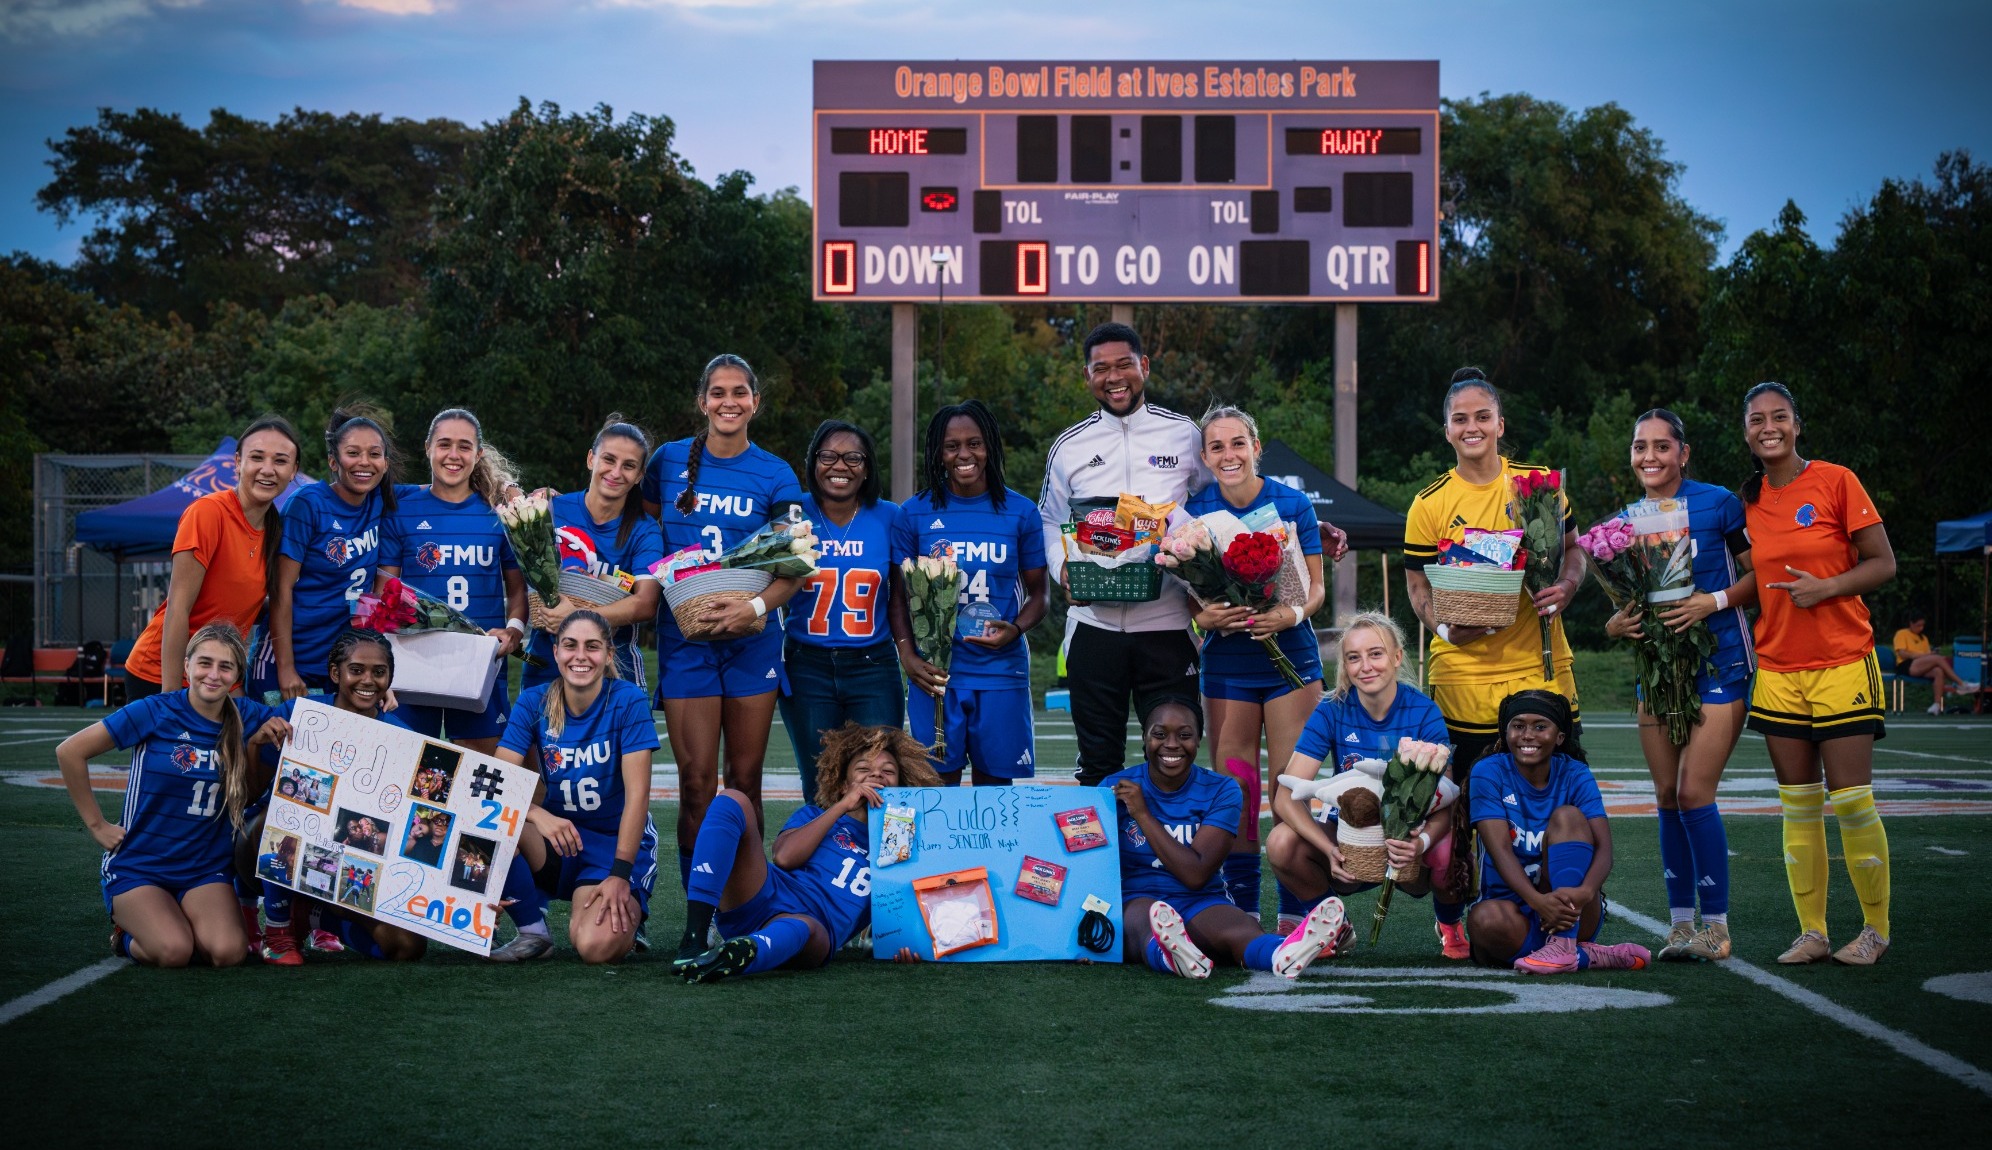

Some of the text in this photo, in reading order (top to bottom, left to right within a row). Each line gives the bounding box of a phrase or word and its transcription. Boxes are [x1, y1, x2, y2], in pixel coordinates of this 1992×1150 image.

[895, 66, 1357, 104] Orange Bowl Field at Ives Estates Park
[870, 129, 928, 154] HOME
[1321, 129, 1382, 154] AWAY
[1004, 201, 1042, 224] TOL
[1211, 201, 1249, 224] TOL
[864, 245, 963, 285] DOWN
[1055, 245, 1099, 285] TO
[1115, 245, 1161, 285] GO
[1188, 245, 1234, 285] ON
[1326, 245, 1390, 291] QTR
[1157, 455, 1179, 465] FMU
[696, 493, 754, 517] FMU
[1133, 516, 1159, 531] Lay's
[346, 525, 379, 560] FMU
[438, 544, 494, 567] FMU
[701, 525, 723, 561] 3
[820, 540, 864, 557] FMU
[951, 541, 1007, 564] FMU
[344, 567, 368, 601] 2
[446, 575, 469, 612] 8
[802, 567, 882, 637] 79
[295, 709, 403, 814] Rudo
[560, 740, 611, 769] FMU
[187, 780, 221, 817] 11
[560, 776, 602, 812] 16
[915, 788, 997, 832] Rudo
[475, 799, 520, 837] 24
[947, 833, 993, 850] SENIOR
[997, 838, 1019, 852] Night
[830, 856, 872, 897] 18
